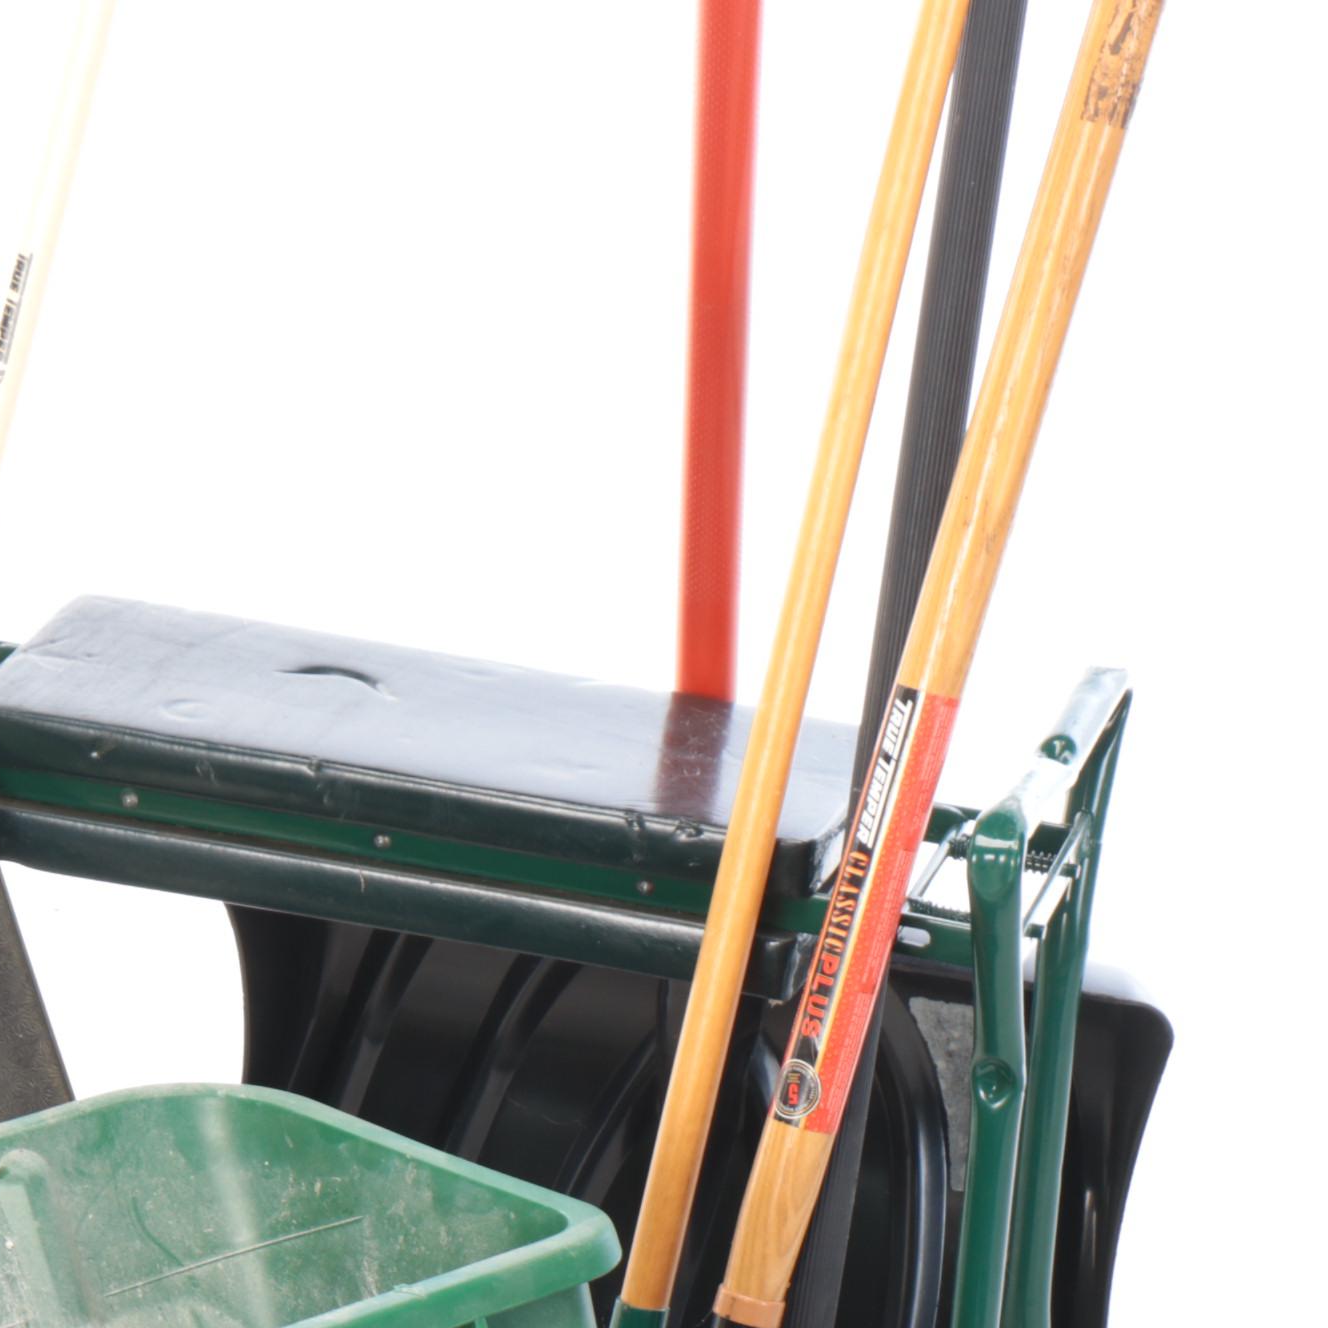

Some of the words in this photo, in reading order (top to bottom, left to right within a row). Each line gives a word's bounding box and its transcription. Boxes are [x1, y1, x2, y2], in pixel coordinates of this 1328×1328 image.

[9, 253, 29, 292] TRUE
[882, 698, 913, 757] TRUE
[856, 757, 894, 848] TEMPER
